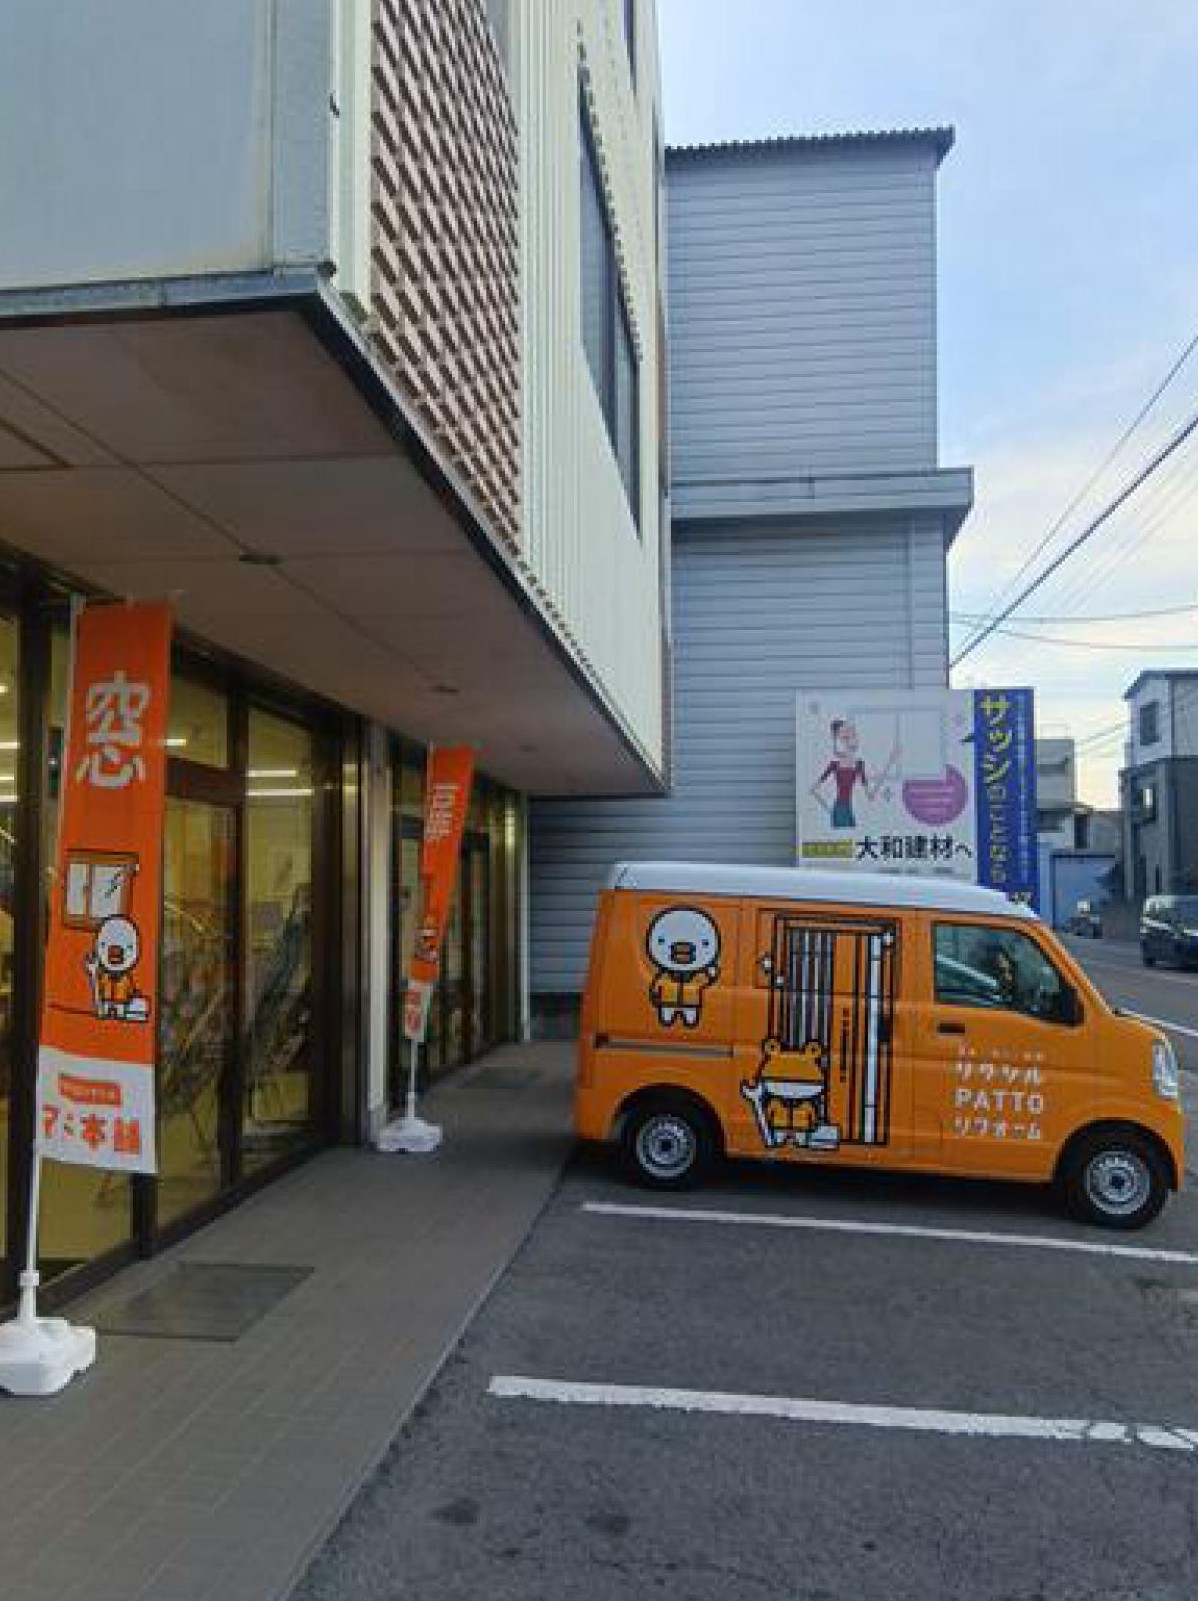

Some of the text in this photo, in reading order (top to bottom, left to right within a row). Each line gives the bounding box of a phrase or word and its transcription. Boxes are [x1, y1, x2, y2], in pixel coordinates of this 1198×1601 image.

[75, 670, 150, 788] 窓
[856, 835, 972, 862] 大和建材へ
[955, 1089, 1043, 1114] PATTO
